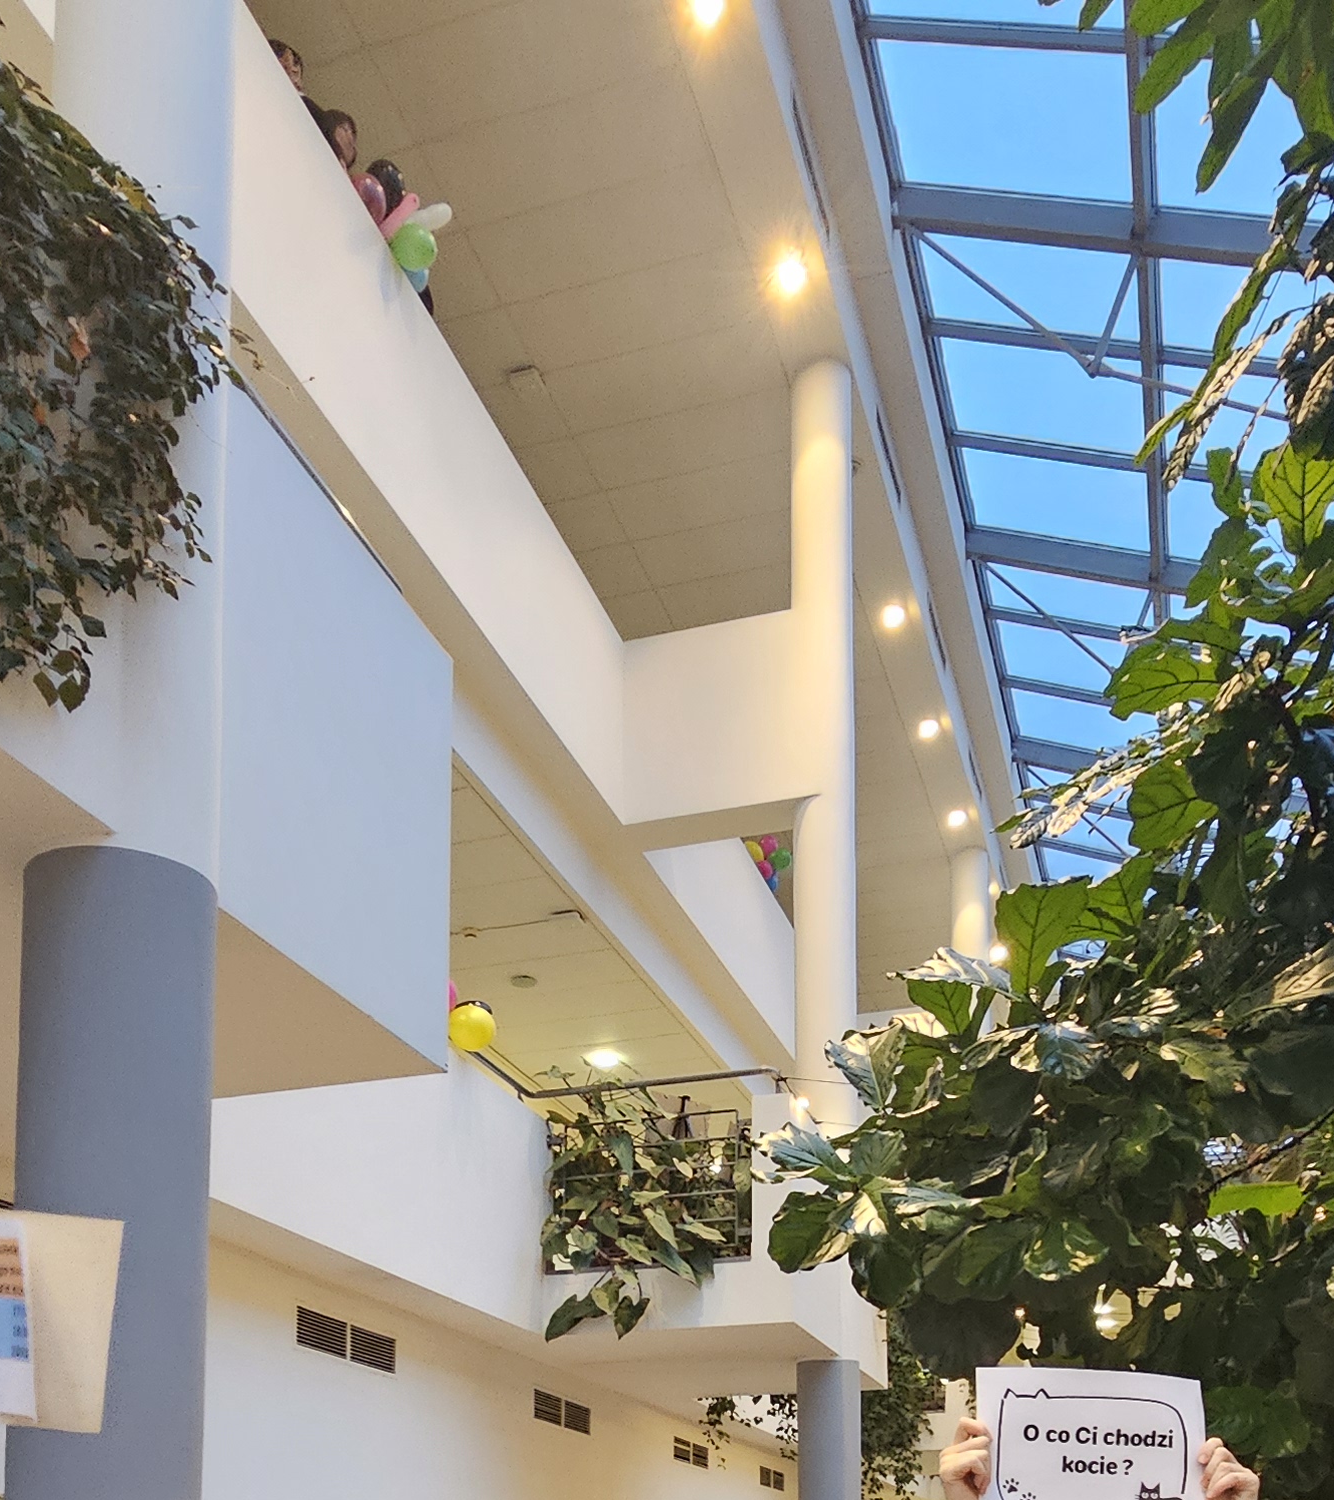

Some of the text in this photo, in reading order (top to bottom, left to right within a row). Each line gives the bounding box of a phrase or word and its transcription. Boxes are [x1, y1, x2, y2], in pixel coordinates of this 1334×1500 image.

[1023, 1424, 1174, 1449] O co Ci chodzi
[1062, 1456, 1134, 1476] kocie ?
